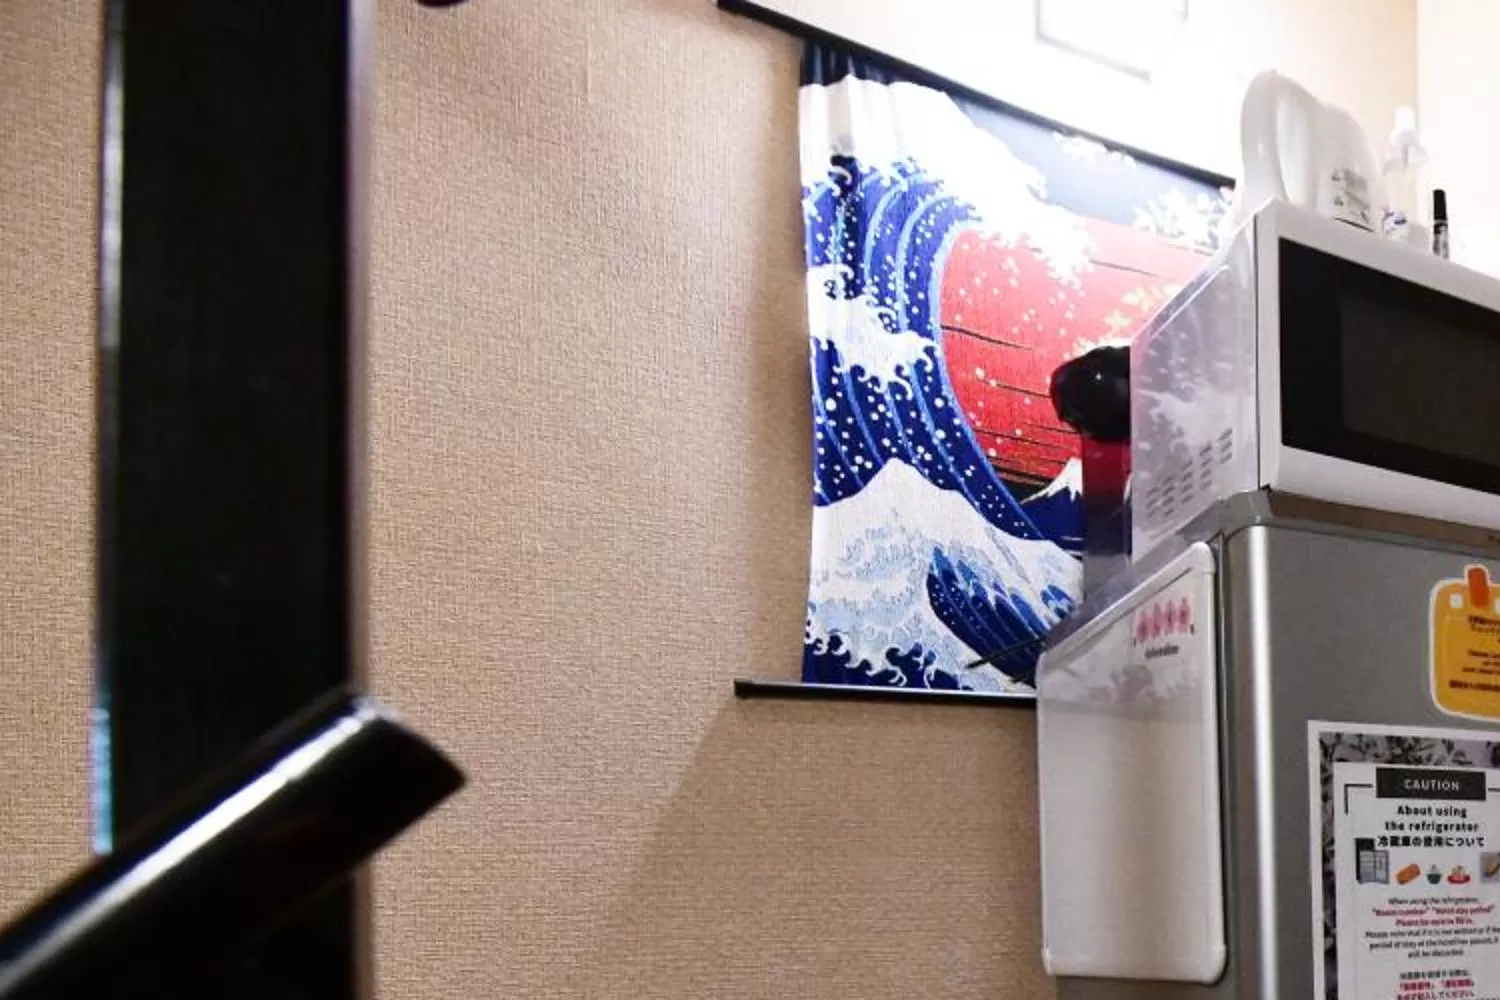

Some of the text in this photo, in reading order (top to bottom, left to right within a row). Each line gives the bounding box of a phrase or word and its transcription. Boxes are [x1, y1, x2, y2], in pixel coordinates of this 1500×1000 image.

[1403, 779, 1460, 792] CAUTION
[1397, 805, 1467, 819] About using
[1384, 820, 1479, 834] the refrigerator
